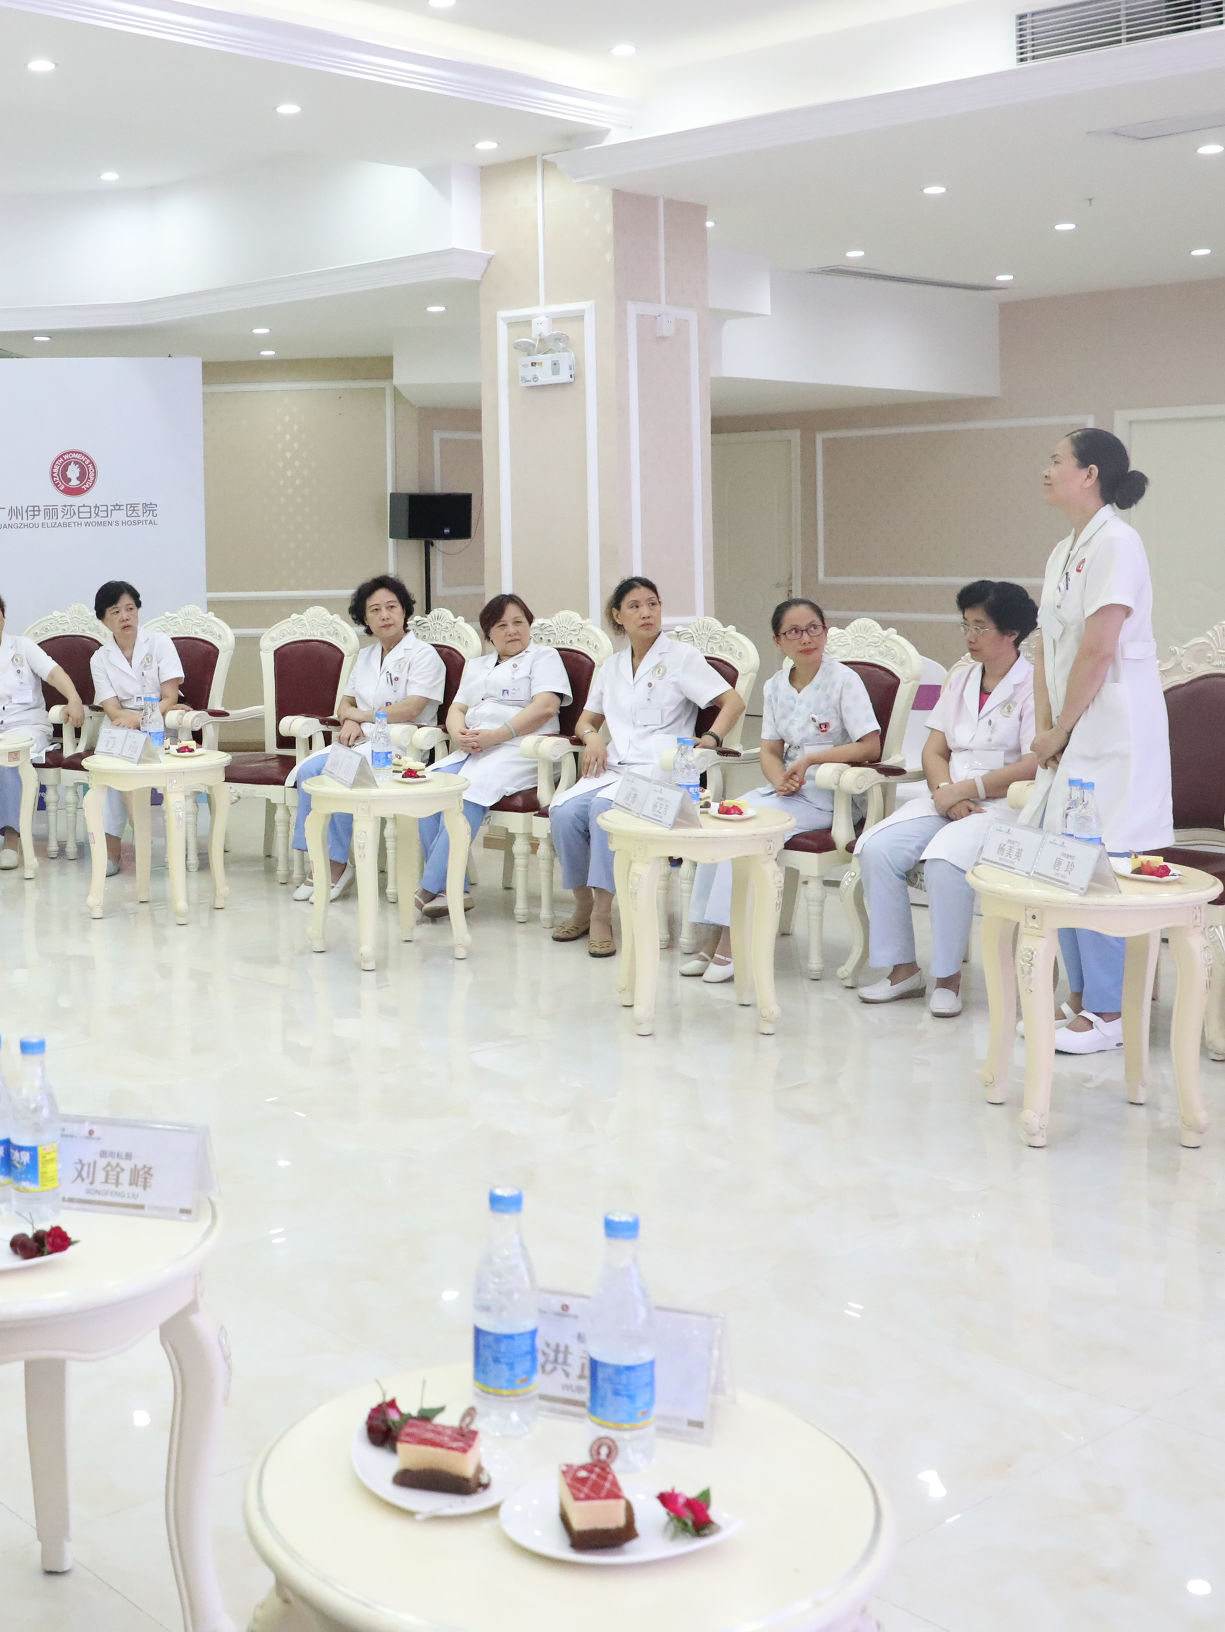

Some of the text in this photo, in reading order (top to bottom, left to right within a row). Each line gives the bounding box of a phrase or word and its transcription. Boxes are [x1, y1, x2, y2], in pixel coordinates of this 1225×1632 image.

[41, 521, 83, 529] ELIZABETH
[84, 519, 120, 528] WOMEN'S
[121, 518, 158, 527] HOSPITAL
[71, 1157, 154, 1191] 刘耸峰
